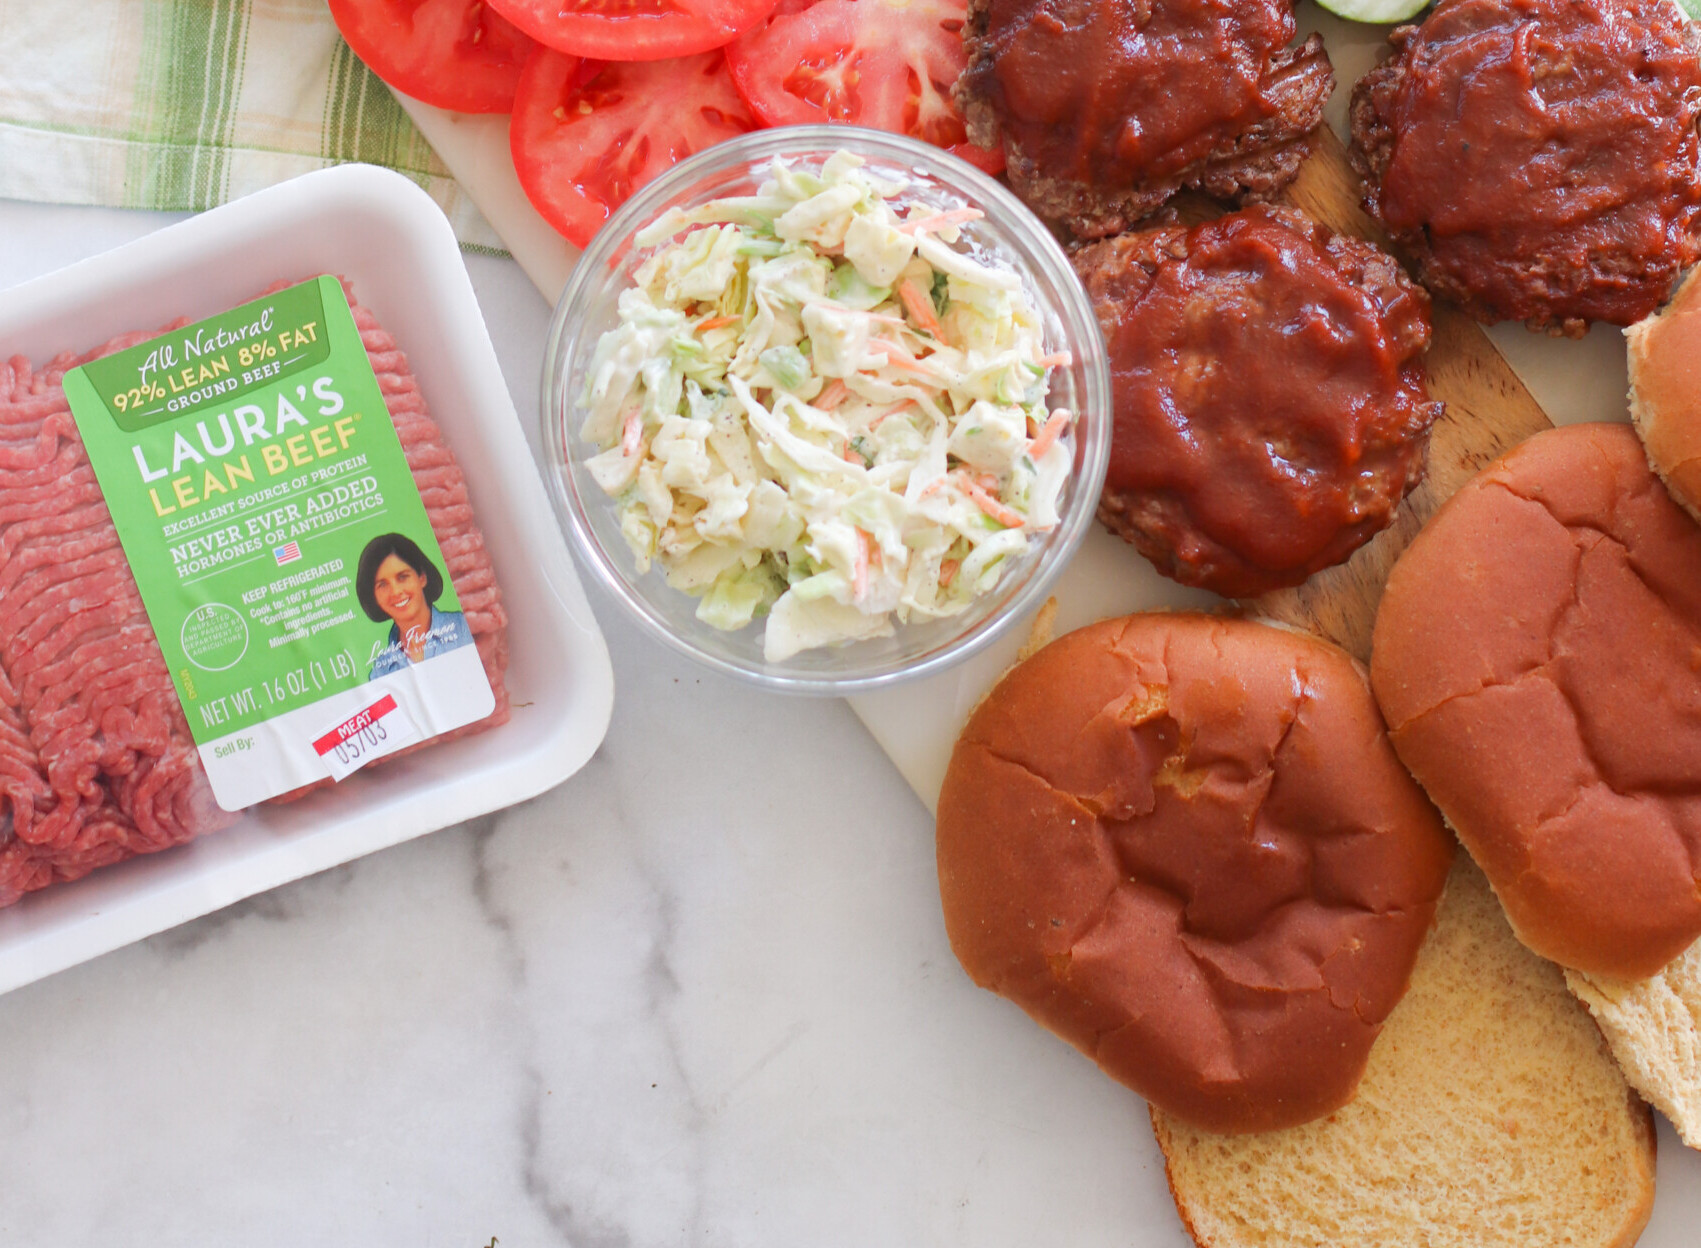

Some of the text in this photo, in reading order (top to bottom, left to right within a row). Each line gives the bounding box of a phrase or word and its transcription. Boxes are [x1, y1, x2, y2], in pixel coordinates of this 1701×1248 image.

[114, 321, 318, 412] 92% LEAN 8% FAT
[138, 345, 178, 385] All
[167, 361, 281, 412] GROUND BEEF
[132, 376, 344, 483] LAURA'S
[149, 455, 255, 517] LEAN
[162, 454, 367, 537] EXCELLENT SOURCE OF PROTEIN
[170, 476, 378, 564] NEVER EVER ADDED
[176, 493, 384, 578] HORMONES OR ANTIBIOTICS
[242, 558, 344, 605] KEEP REFRIGERATED
[250, 603, 272, 618] Cook
[272, 600, 285, 610] to:
[310, 576, 351, 596] minimum.
[302, 602, 312, 612] no
[315, 586, 349, 607] artificial
[196, 607, 217, 621] U.S.
[269, 609, 356, 648] Minimally processed.
[284, 607, 333, 630] ingredients.
[200, 648, 357, 728] NET WT. 16 OZ (1 LB)
[214, 736, 256, 759] Sell By:
[337, 709, 372, 739] MEAT
